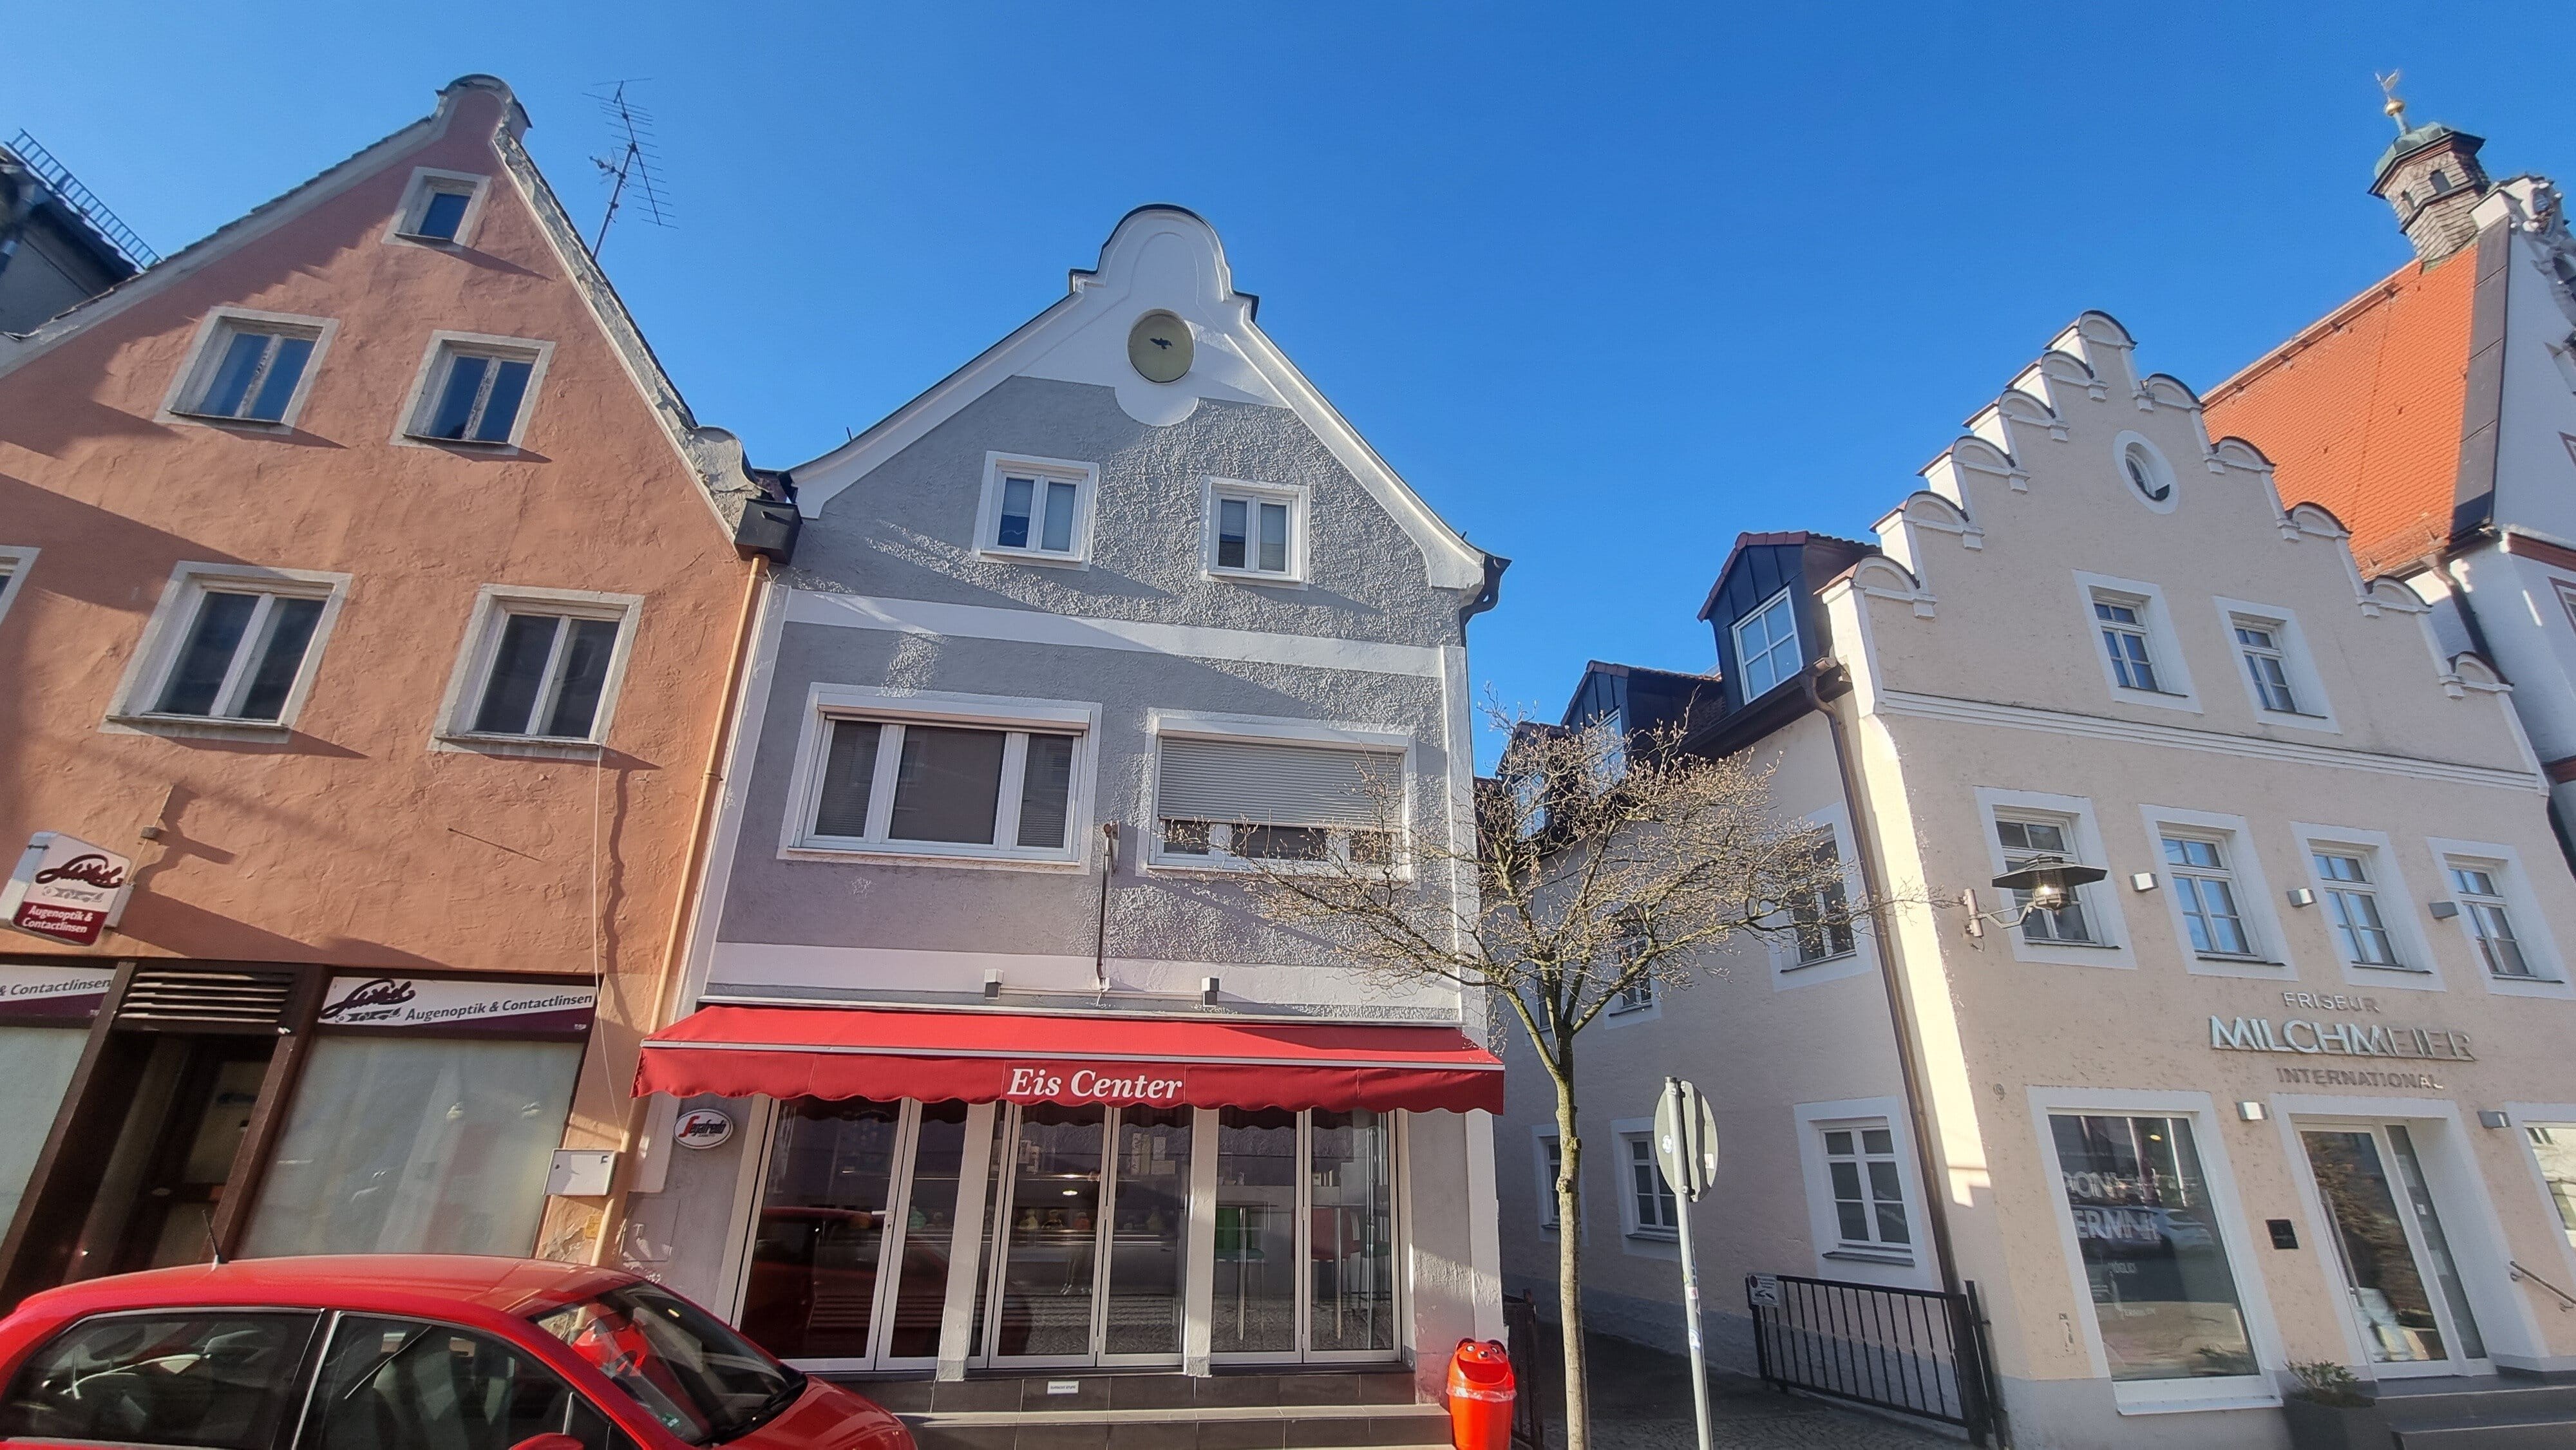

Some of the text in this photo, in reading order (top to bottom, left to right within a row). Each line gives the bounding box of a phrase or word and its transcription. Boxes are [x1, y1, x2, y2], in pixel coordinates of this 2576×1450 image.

[28, 905, 93, 922] Augenoptik &
[22, 918, 88, 934] Contactlinsen
[10, 979, 111, 995] Contactlinsen
[405, 994, 592, 1022] Augenoptik & Contactlinsen
[2282, 991, 2380, 1013] FRISEUR
[2209, 1014, 2478, 1061] MILCHMEIER
[1007, 1068, 1183, 1099] Eis Center
[2276, 1067, 2445, 1090] INTERNATIONAL
